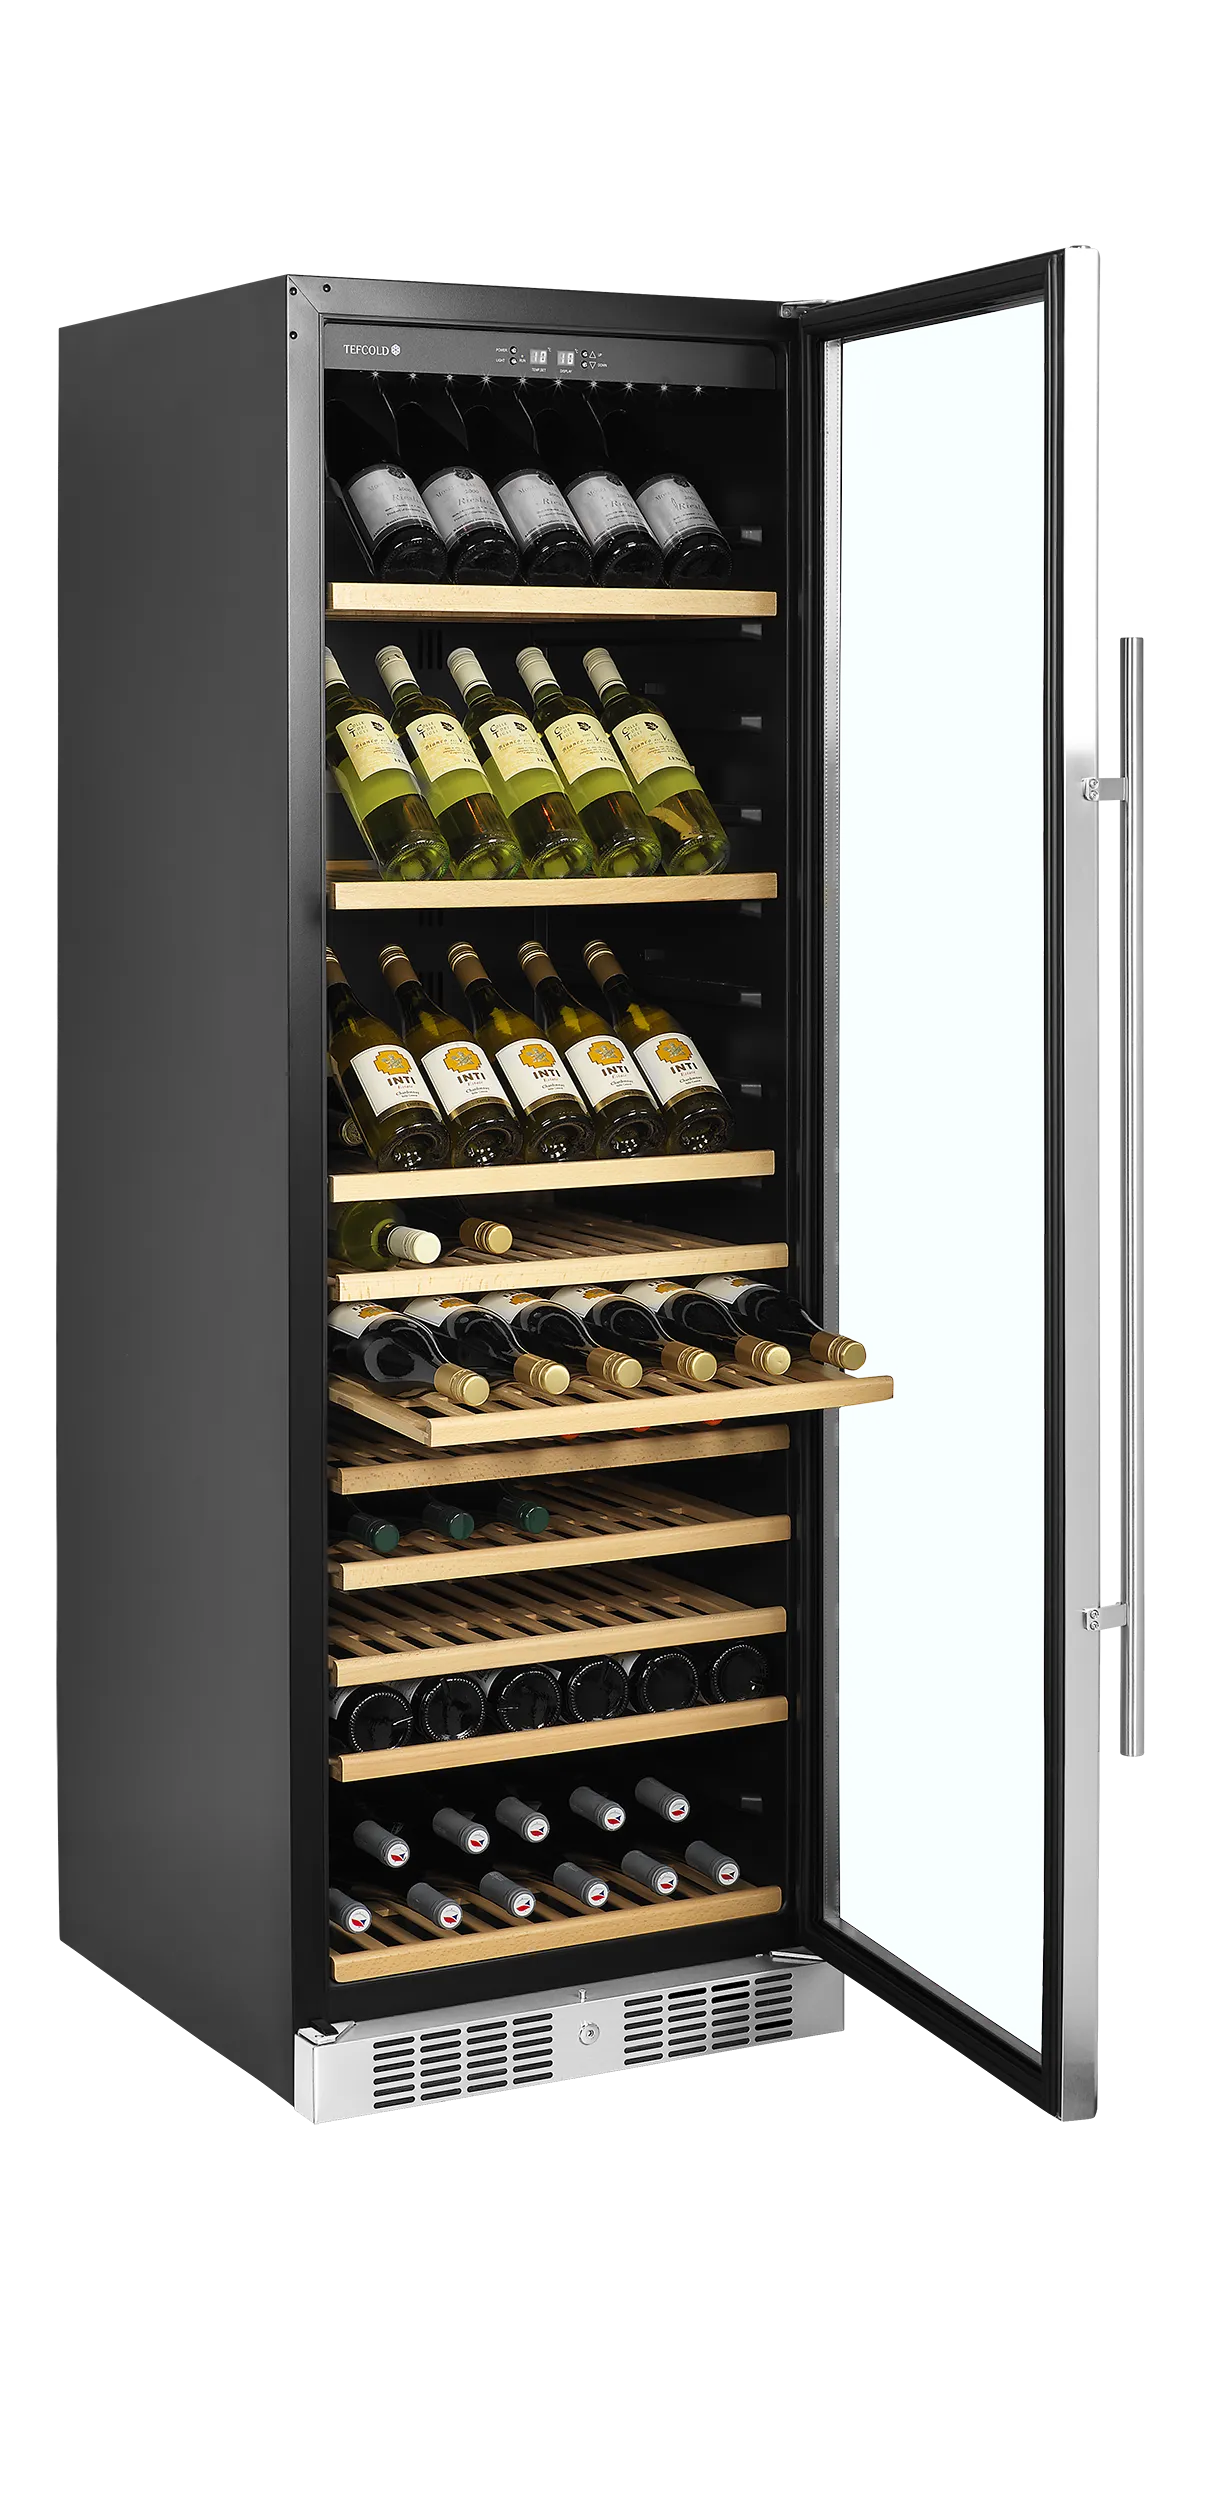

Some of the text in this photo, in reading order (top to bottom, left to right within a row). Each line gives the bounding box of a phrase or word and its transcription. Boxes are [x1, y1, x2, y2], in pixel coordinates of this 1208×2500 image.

[343, 344, 389, 356] TEFCOLD
[602, 1066, 630, 1076] INTI
[670, 1062, 698, 1074] INTI
[457, 1072, 486, 1084] INTI
[532, 1069, 561, 1080] INTI
[387, 1076, 416, 1086] INTI
